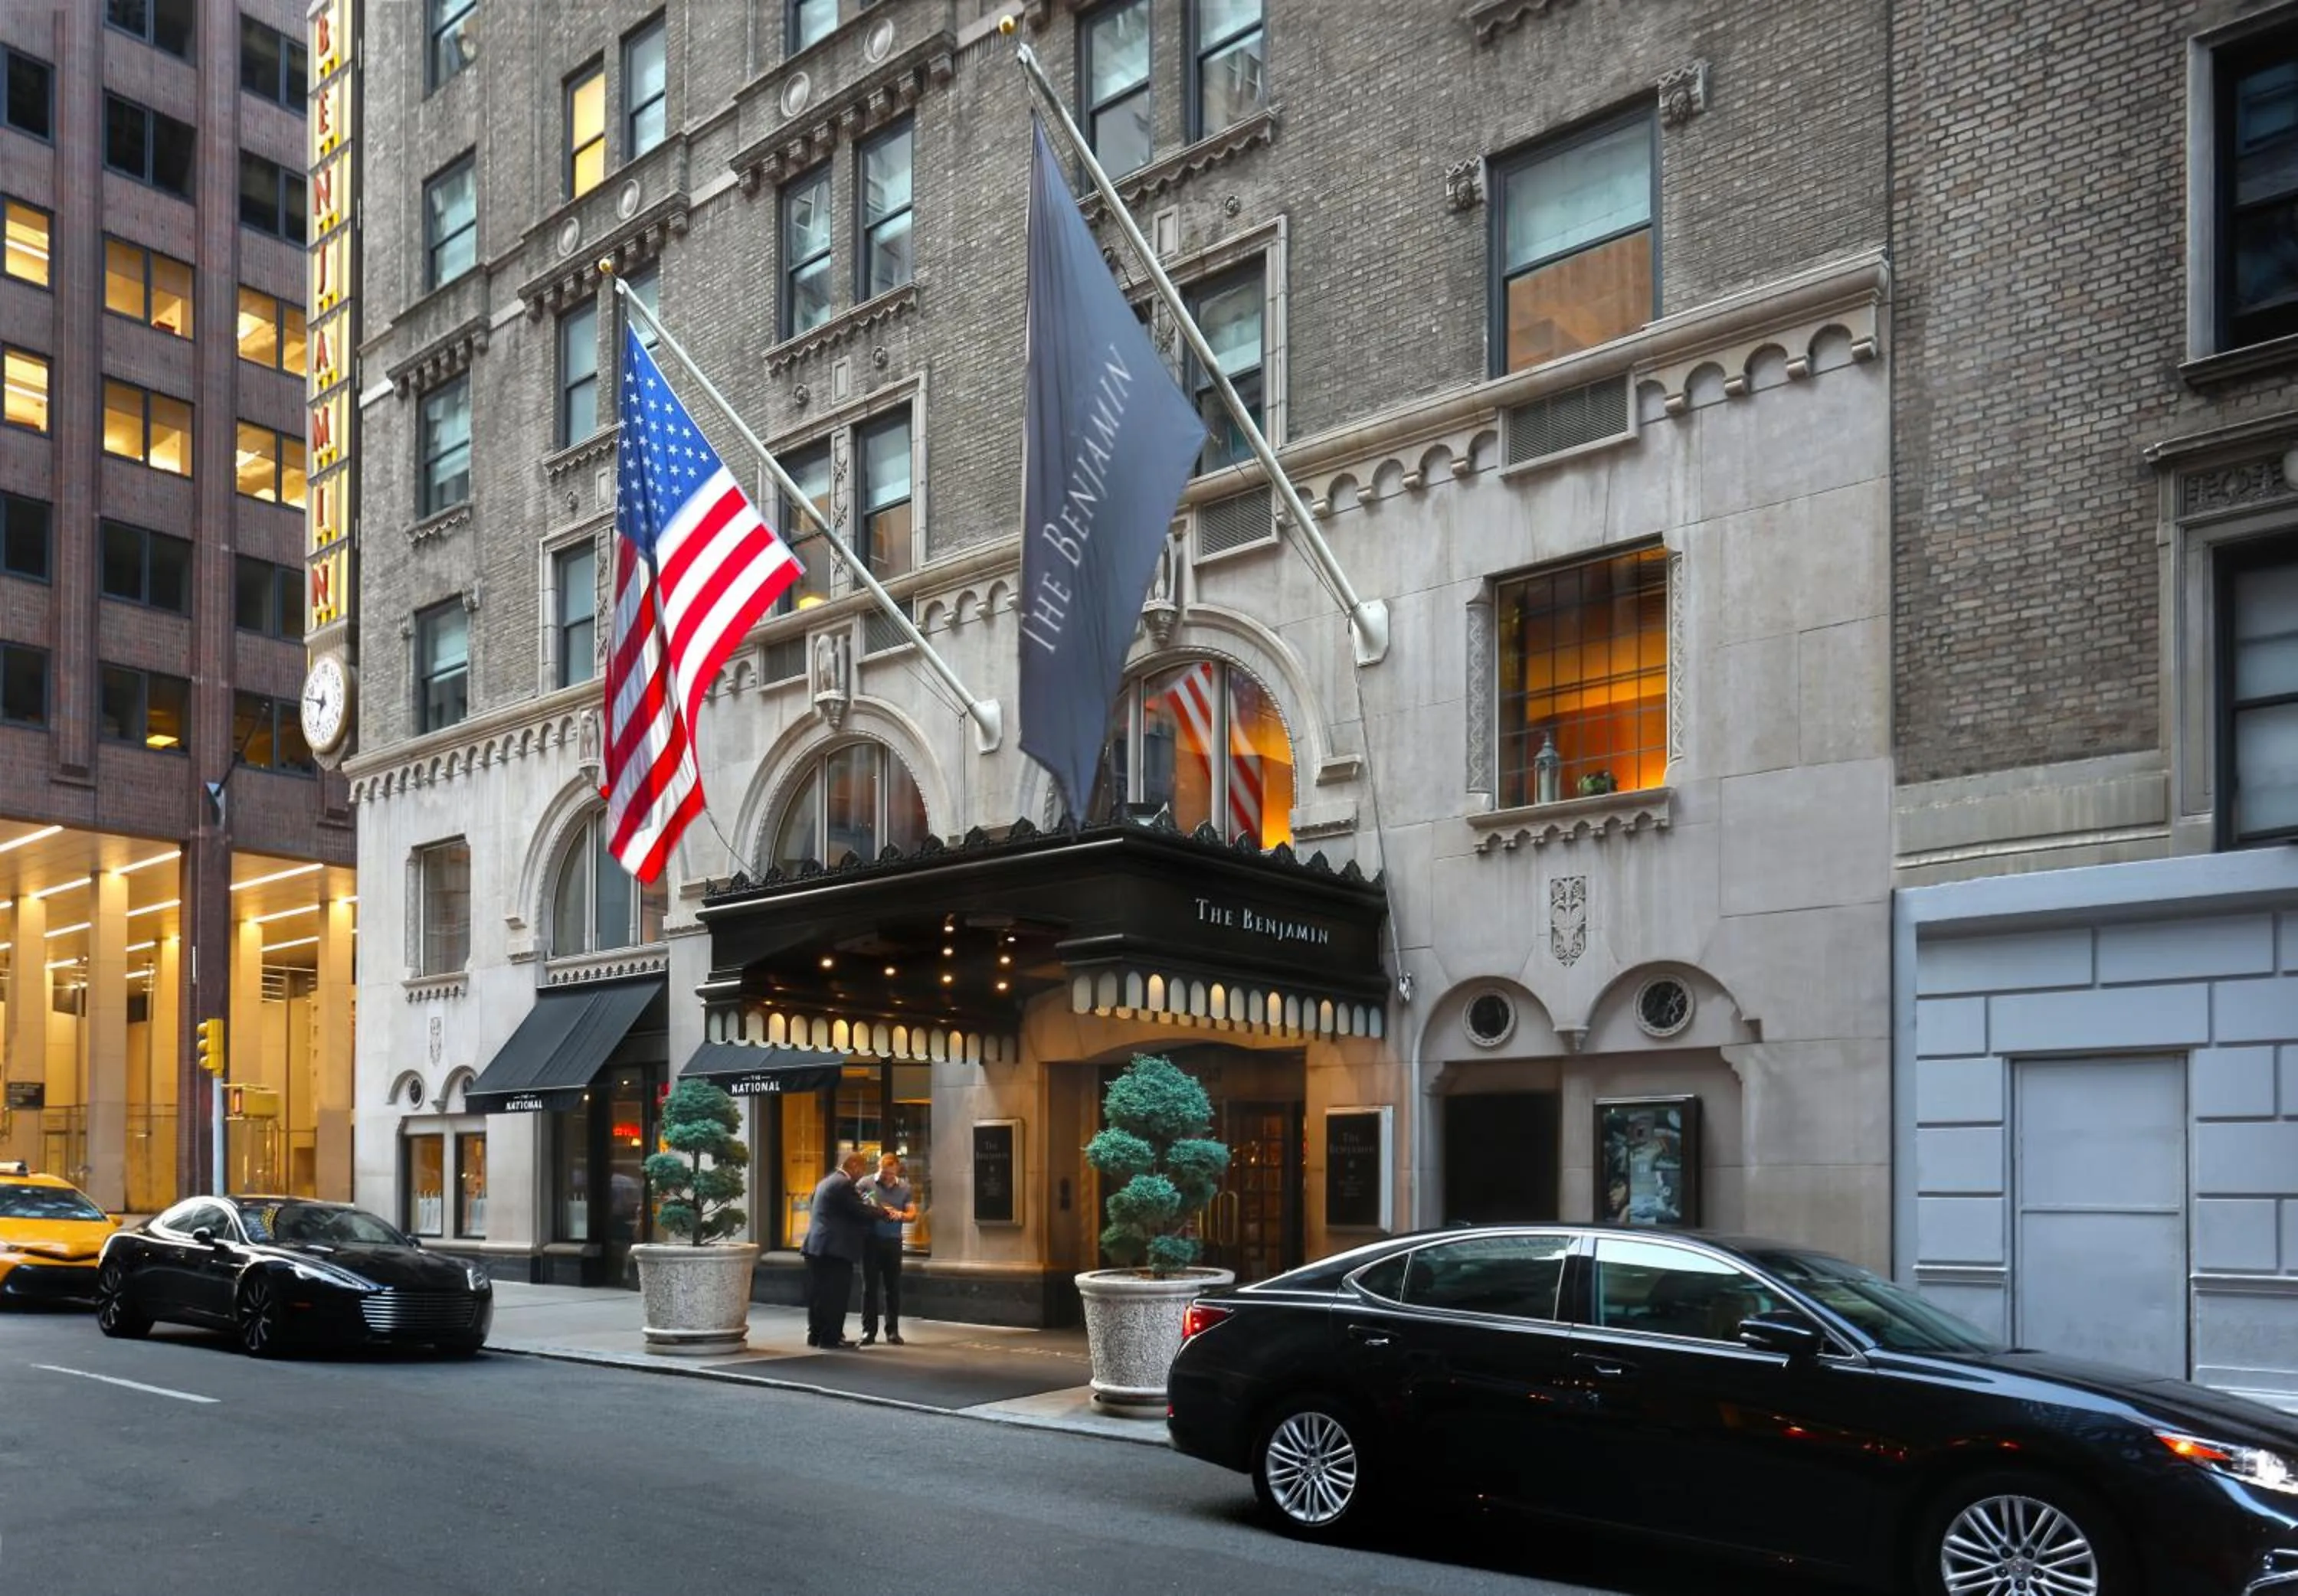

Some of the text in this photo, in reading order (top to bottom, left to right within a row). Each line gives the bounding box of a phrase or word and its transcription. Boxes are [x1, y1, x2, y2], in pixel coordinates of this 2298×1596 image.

[313, 15, 332, 608] BENJAMIN
[1021, 343, 1133, 655] THE BENJAMIN
[1195, 898, 1329, 944] THE BENJAMIN
[506, 1099, 542, 1110] NATIONAL
[732, 1081, 781, 1094] NATIONAL
